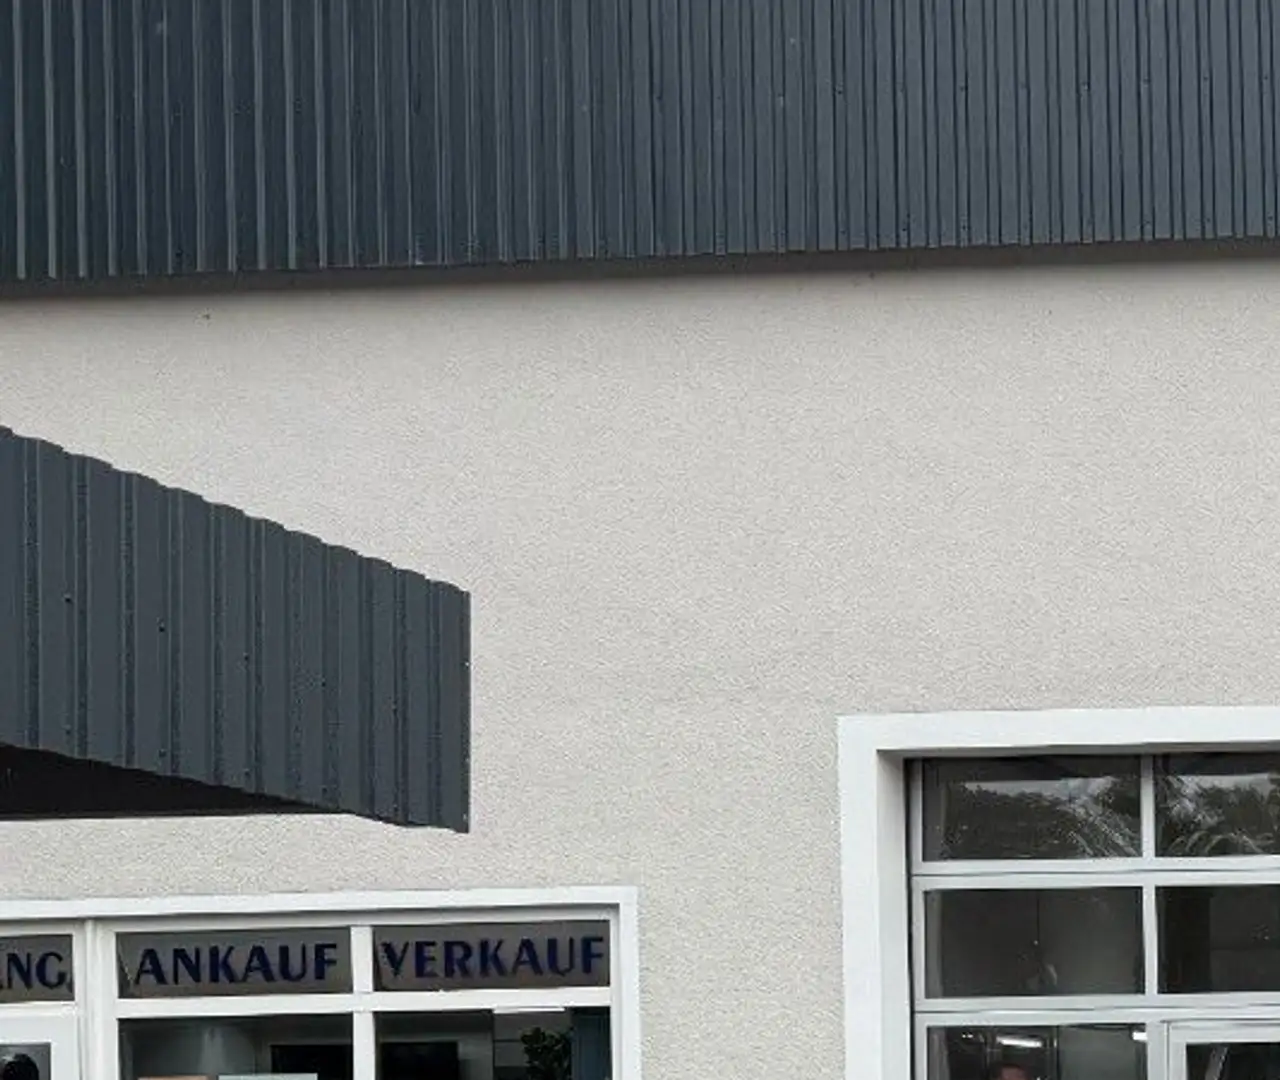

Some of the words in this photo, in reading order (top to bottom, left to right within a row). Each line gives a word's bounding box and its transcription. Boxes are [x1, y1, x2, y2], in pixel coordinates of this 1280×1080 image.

[0, 951, 66, 990] NG
[134, 943, 337, 985] ANKAUF
[380, 936, 604, 978] VERKAUF
